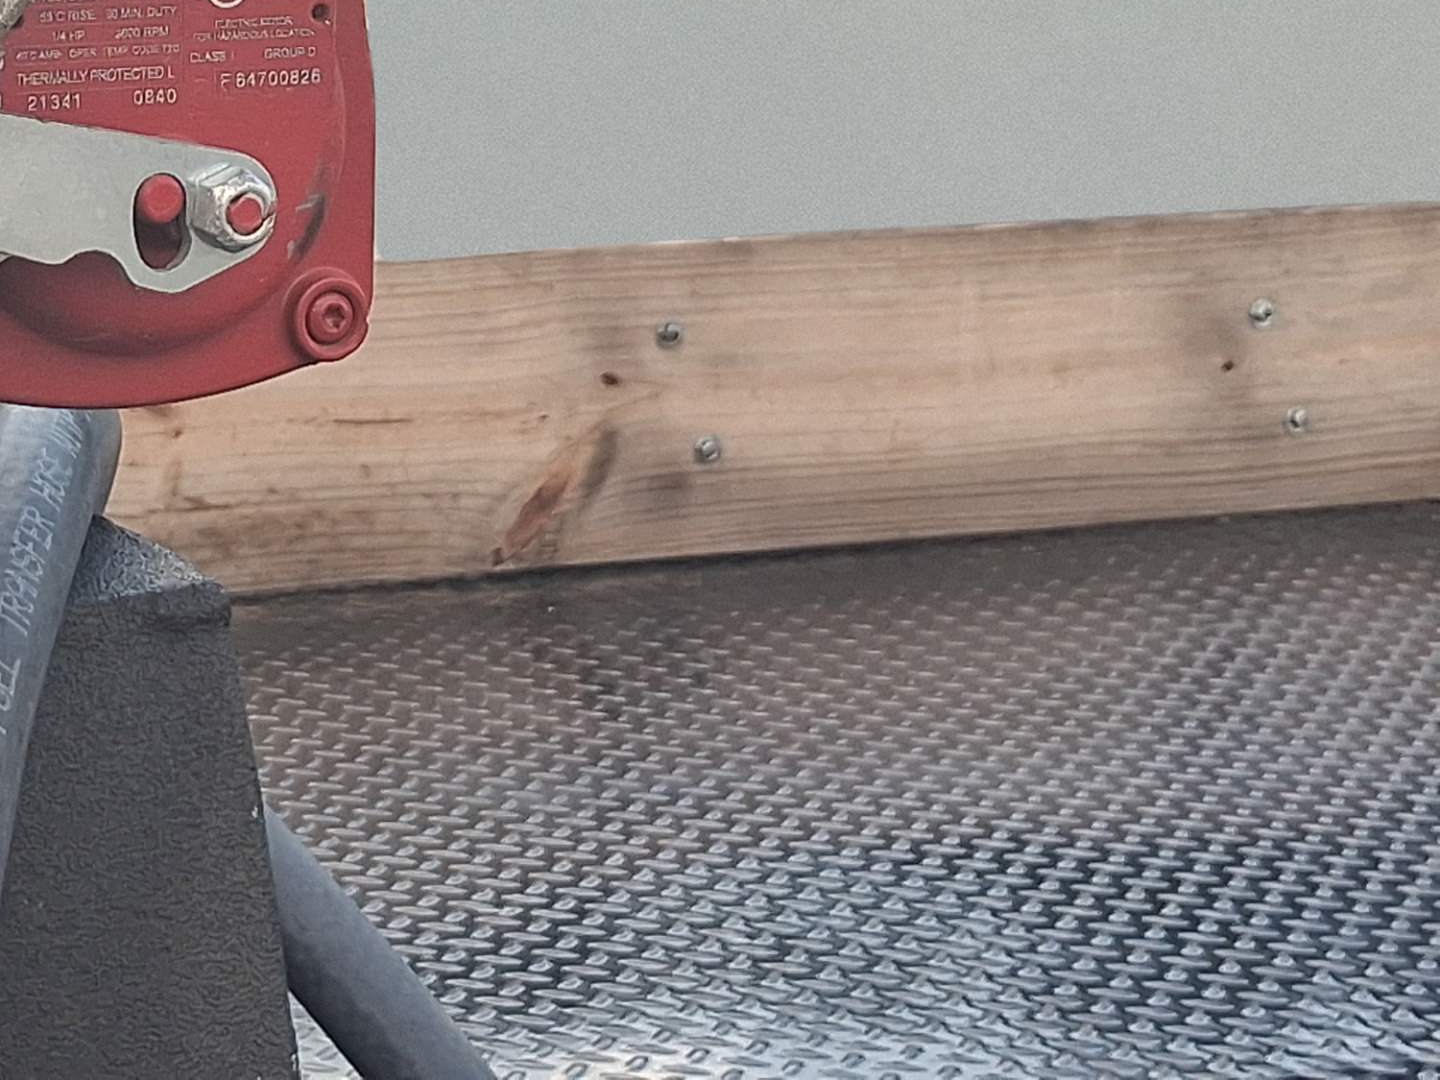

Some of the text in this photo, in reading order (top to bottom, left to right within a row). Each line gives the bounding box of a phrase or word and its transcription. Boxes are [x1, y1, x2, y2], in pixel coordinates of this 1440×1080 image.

[147, 6, 178, 18] DUTY
[189, 50, 227, 64] CLASS
[263, 47, 305, 60] GROUP
[16, 69, 88, 87] THERMALLY
[90, 66, 164, 82] PROTECTED
[235, 67, 321, 89] 64700826
[27, 92, 82, 112] 21341
